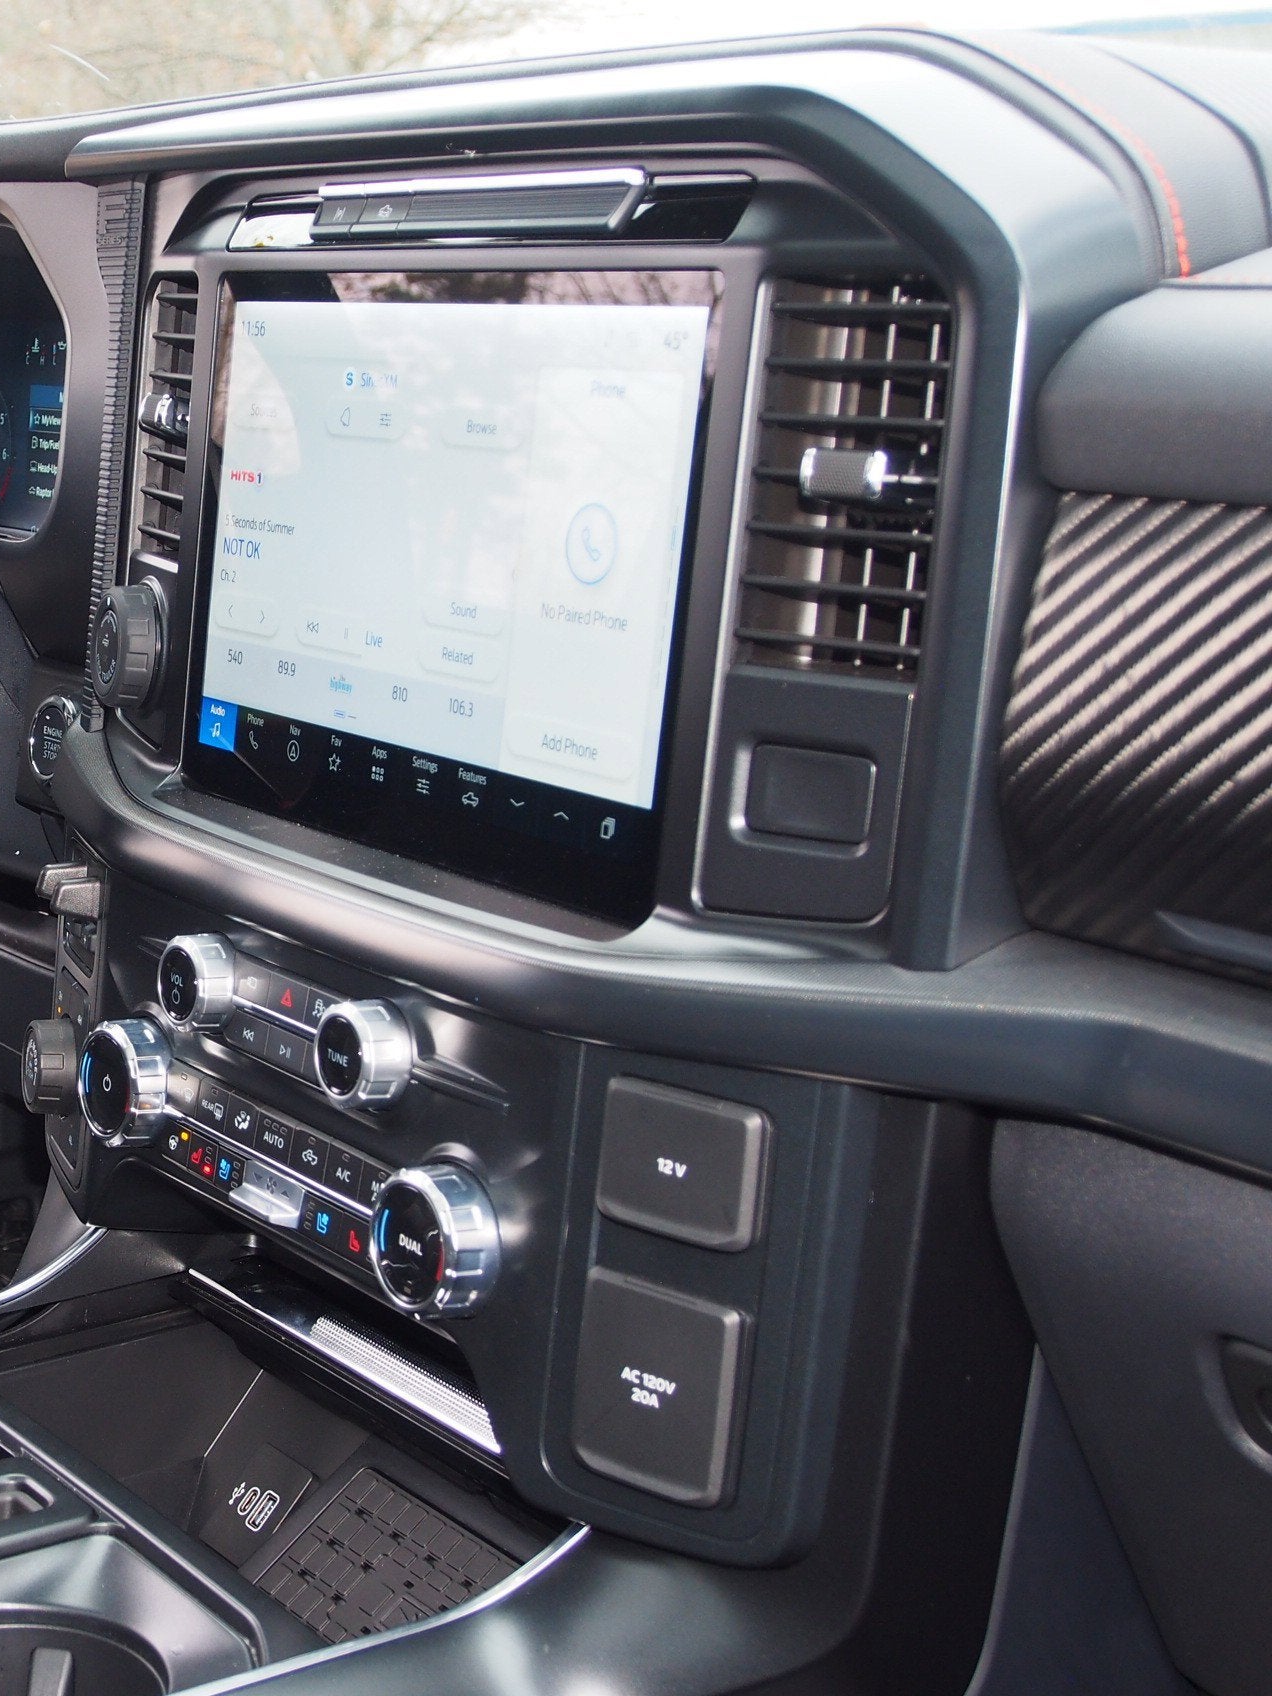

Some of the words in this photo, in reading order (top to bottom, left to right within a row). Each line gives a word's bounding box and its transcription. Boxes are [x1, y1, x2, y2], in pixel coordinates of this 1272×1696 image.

[241, 320, 266, 337] 11:56
[0, 413, 5, 425] 5
[466, 418, 498, 435] Browse
[2, 448, 7, 460] 6
[230, 470, 255, 483] HITS
[257, 472, 263, 484] 1
[231, 514, 258, 531] Seconds
[258, 517, 267, 532] of
[267, 519, 296, 536] Summer
[223, 537, 245, 556] NOT
[246, 540, 262, 560] OK
[231, 570, 237, 583] 2
[450, 602, 477, 619] Sound
[541, 603, 556, 620] No
[557, 604, 592, 626] Paired
[593, 610, 629, 632] Phone
[365, 630, 384, 648] Live
[227, 649, 243, 665] 540
[441, 646, 474, 666] Related
[277, 660, 297, 677] 89.9
[391, 685, 409, 703] 810
[209, 703, 226, 718] Audio
[449, 698, 475, 718] 106.3
[246, 712, 265, 728] Phone
[43, 725, 63, 739] ENGINE
[289, 724, 302, 738] Nav
[330, 734, 343, 749] Fav
[541, 733, 563, 752] Add
[564, 737, 599, 761] Phone
[371, 745, 388, 760] Apps
[412, 755, 439, 775] Settings
[458, 767, 488, 786] Features
[170, 972, 184, 988] VOL
[327, 1048, 349, 1068] TUNE
[201, 1099, 215, 1113] REAR
[263, 1131, 285, 1149] AUTO
[335, 1166, 351, 1183] A/C
[398, 1232, 423, 1257] DUAL
[620, 1366, 642, 1384] AC
[641, 1372, 676, 1395] 120V
[630, 1387, 659, 1409] 20A
